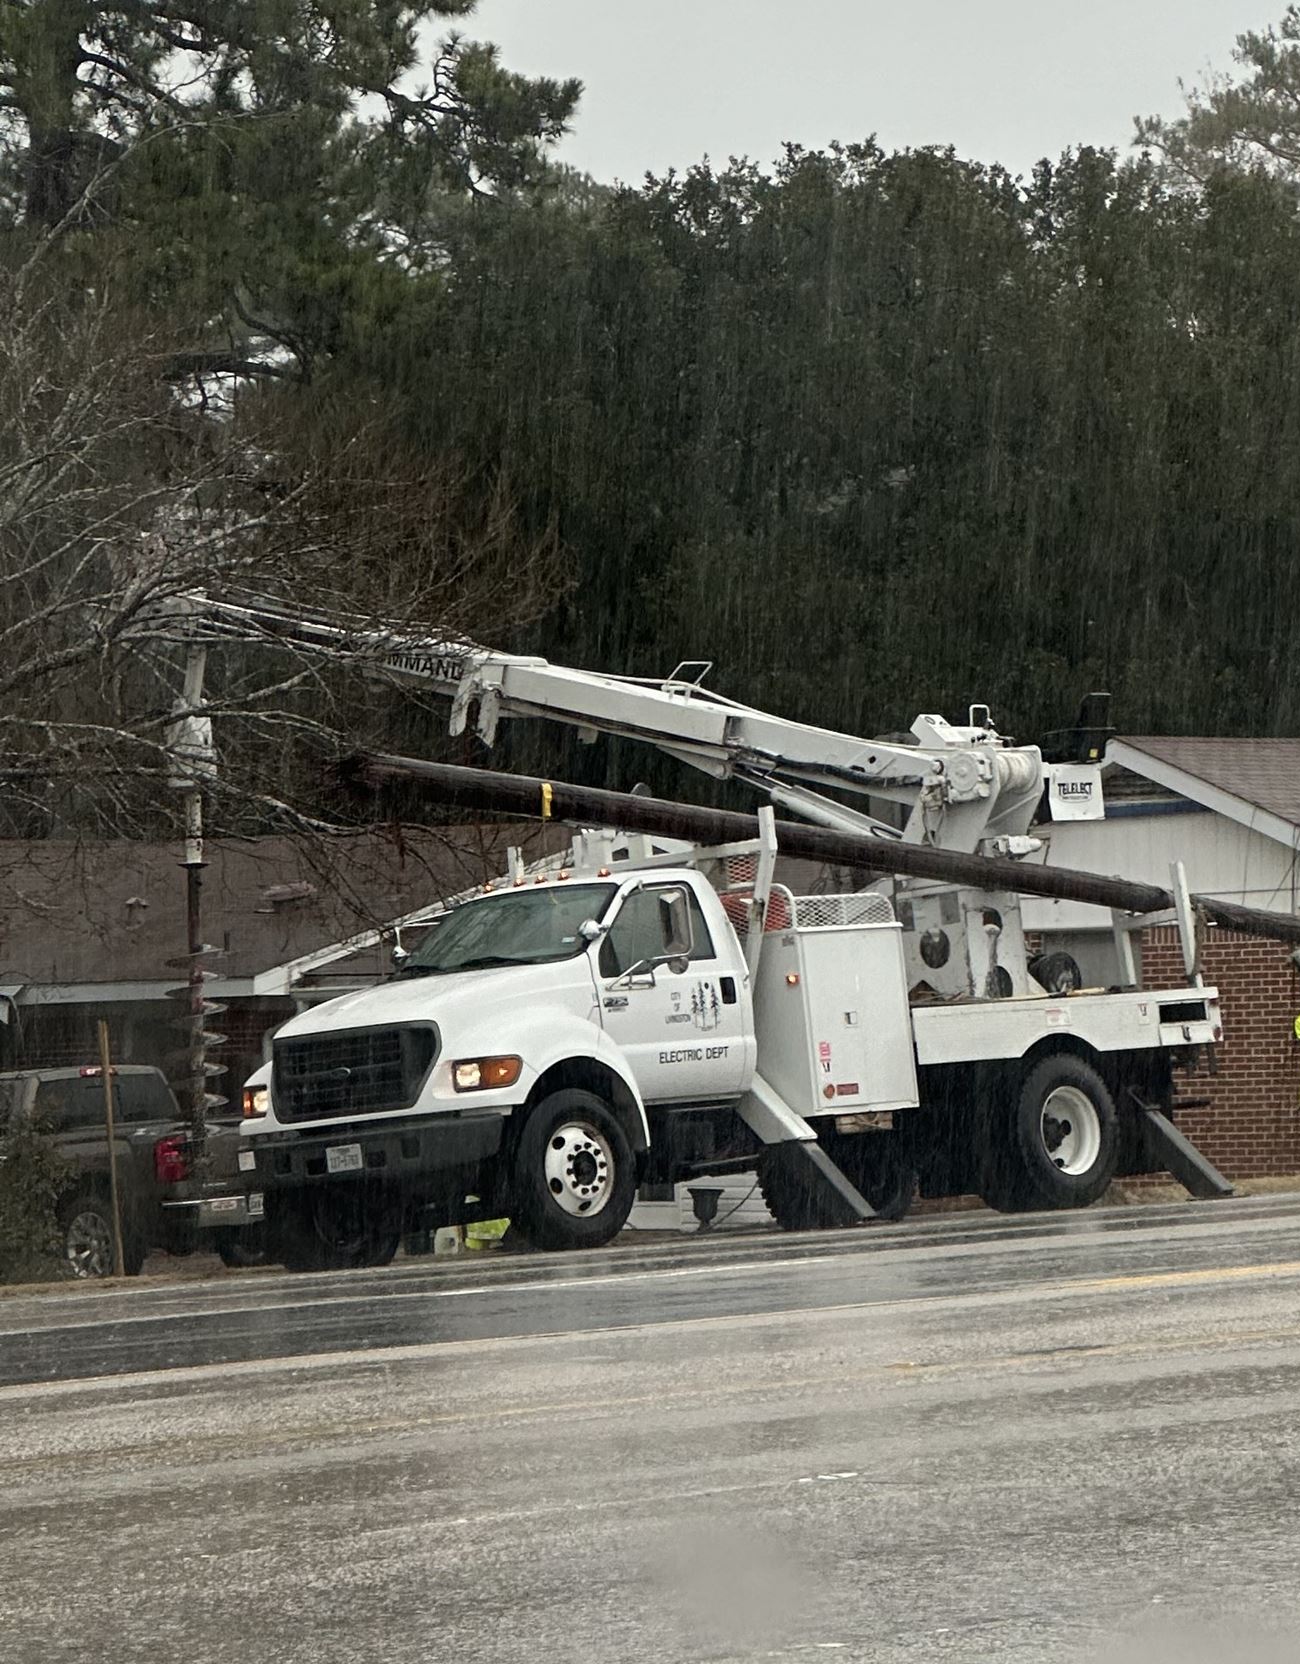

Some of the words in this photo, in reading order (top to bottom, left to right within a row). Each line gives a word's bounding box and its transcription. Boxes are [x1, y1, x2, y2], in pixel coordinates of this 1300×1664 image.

[384, 653, 464, 680] MMAND
[1057, 782, 1093, 797] TELELECT
[659, 1047, 703, 1065] ELECTRIC
[705, 1045, 730, 1060] DEPT
